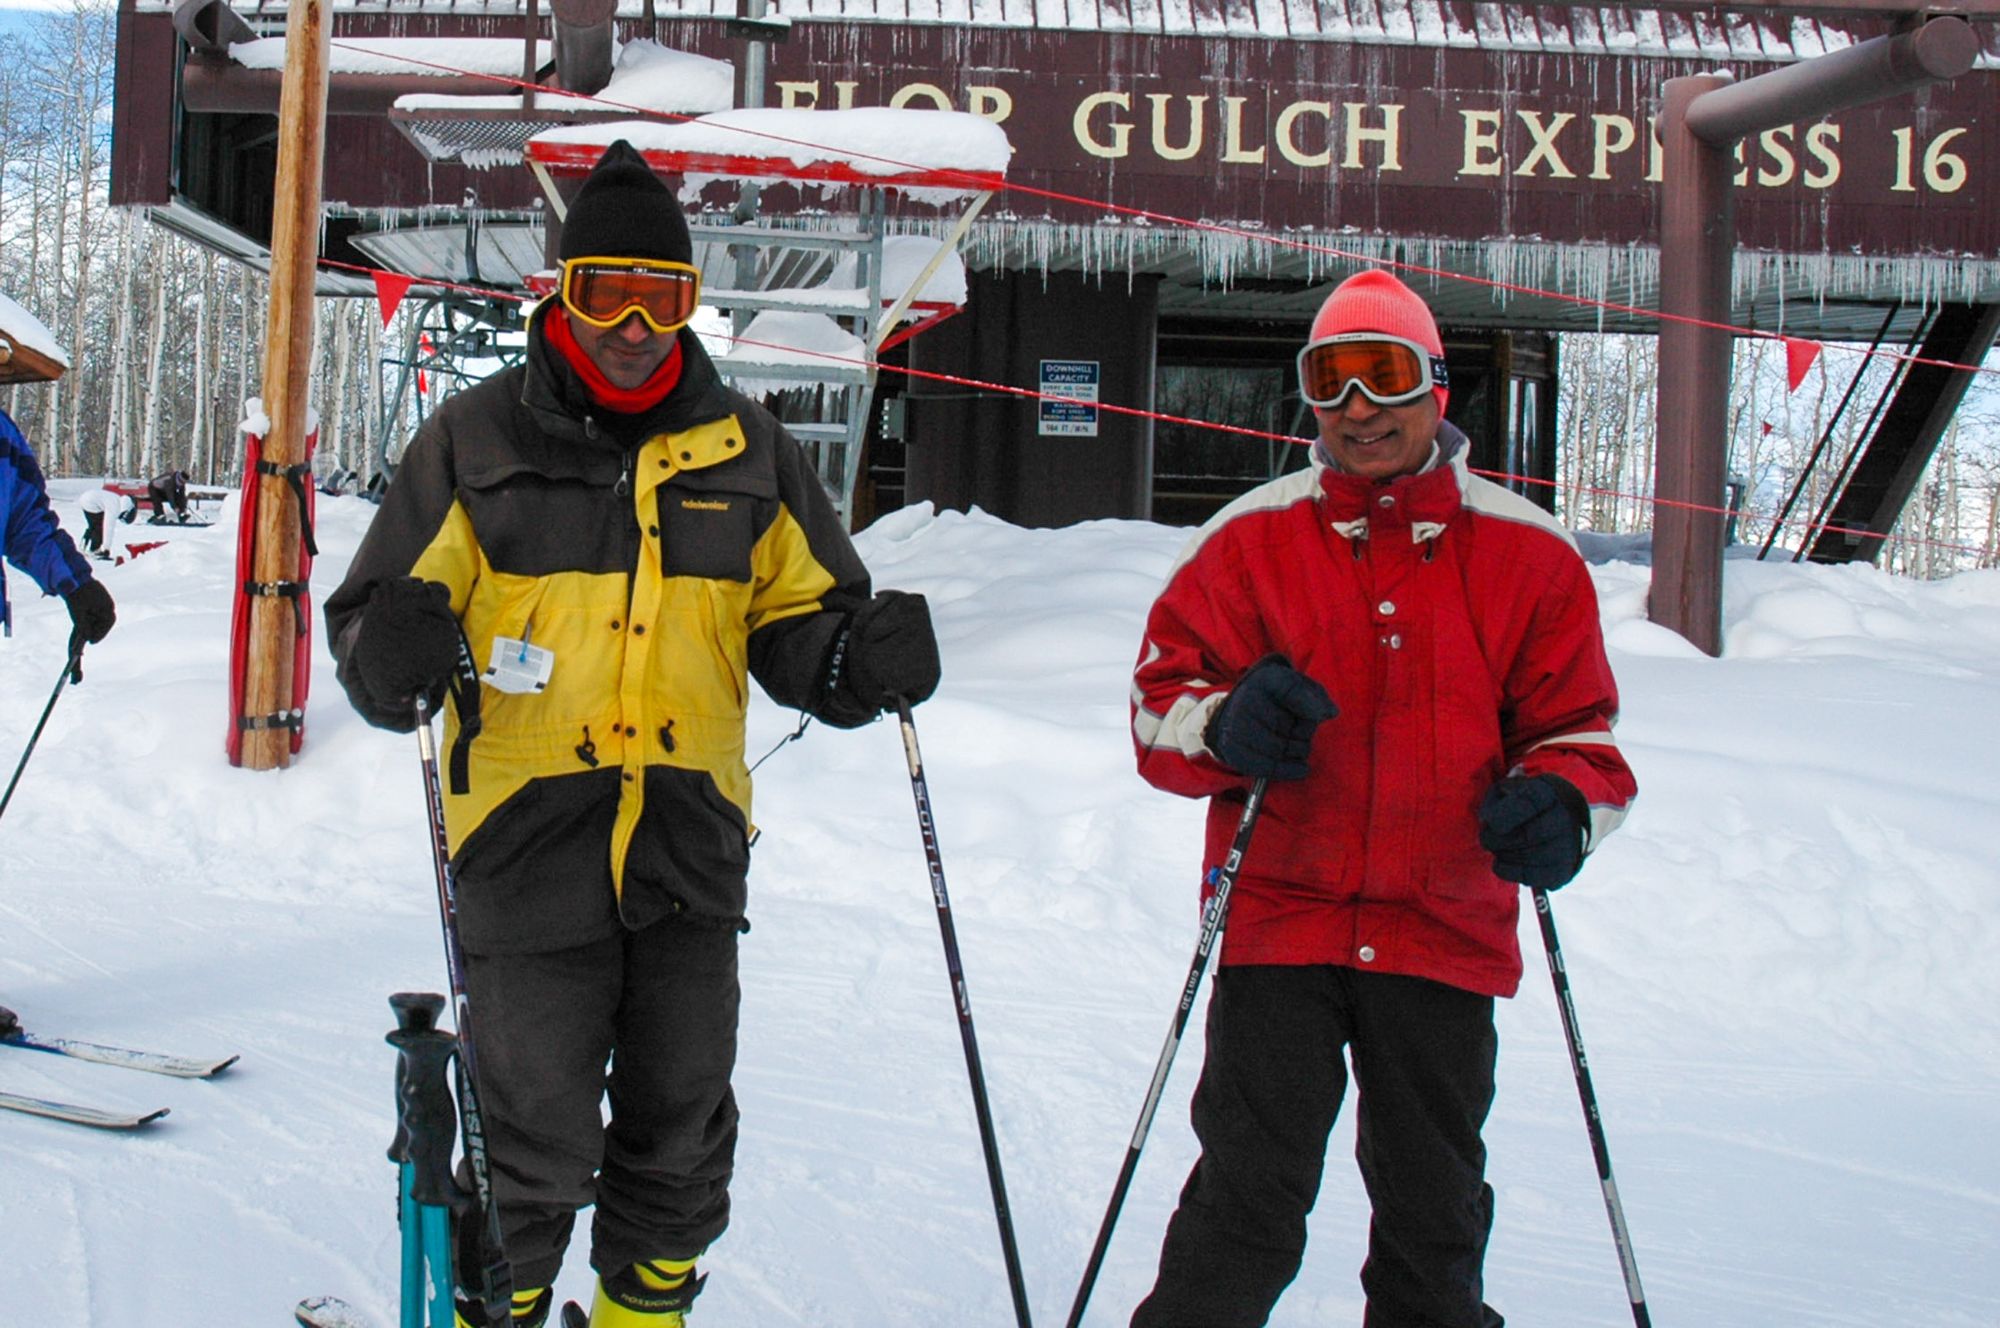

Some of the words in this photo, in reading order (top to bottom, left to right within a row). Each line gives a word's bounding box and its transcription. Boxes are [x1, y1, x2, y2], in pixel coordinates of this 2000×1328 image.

[1073, 91, 1405, 170] GULCH
[1458, 110, 1842, 189] EXPSS
[1890, 126, 1968, 193] 16
[1046, 364, 1092, 373] DOWNHILL
[1048, 374, 1089, 382] CAPACITY
[829, 629, 850, 690] SCOTT
[914, 781, 937, 850] SCOTT
[930, 861, 947, 908] USA
